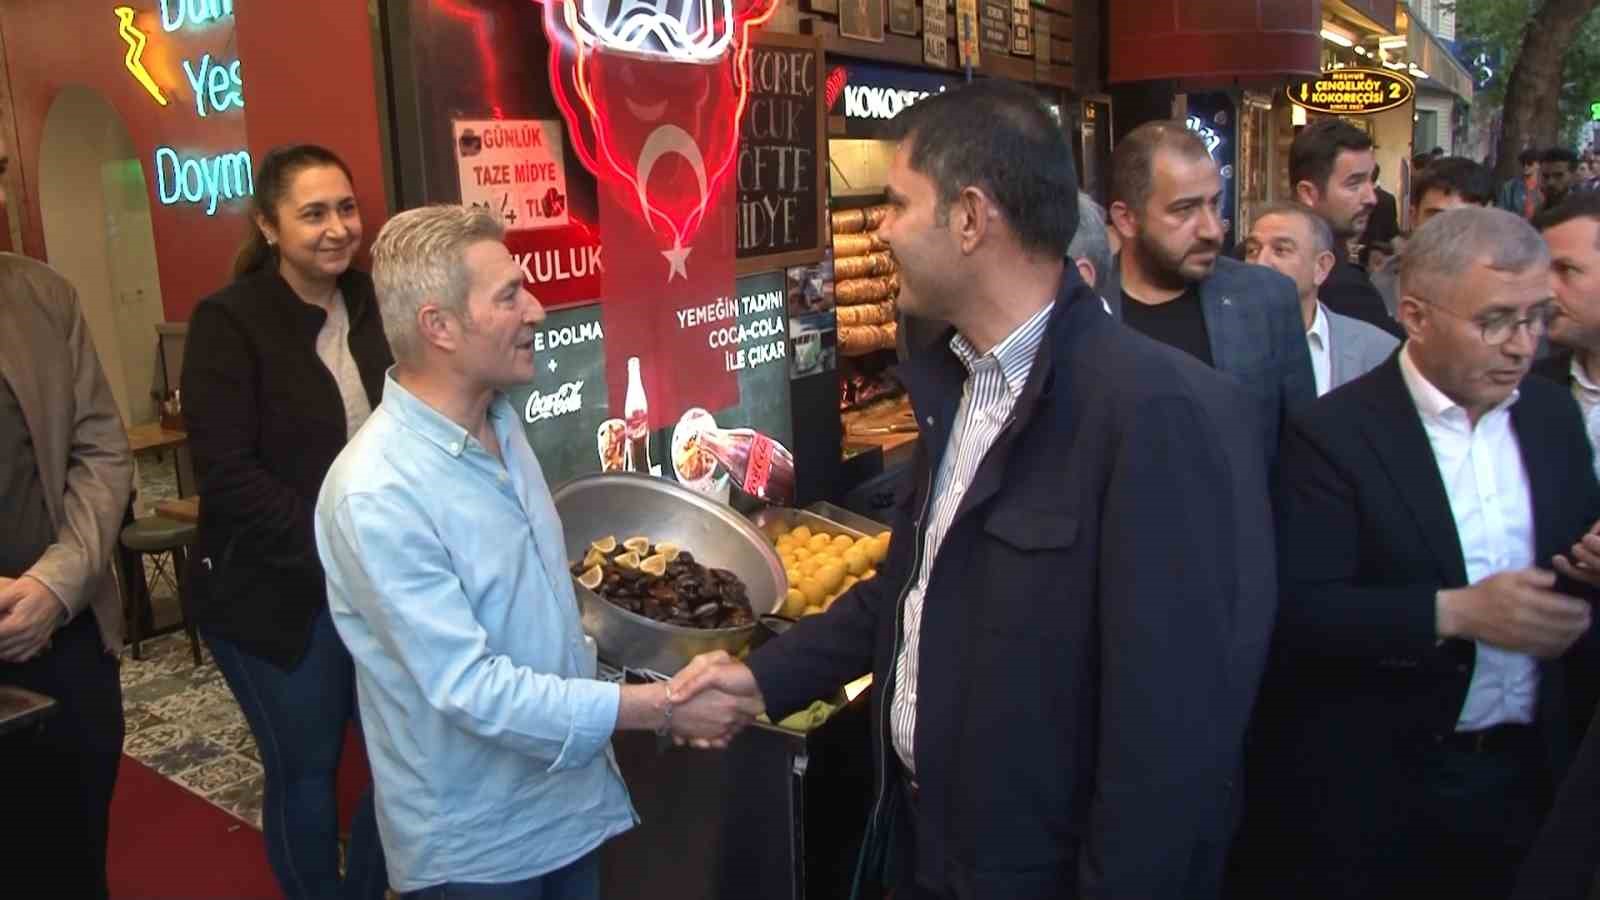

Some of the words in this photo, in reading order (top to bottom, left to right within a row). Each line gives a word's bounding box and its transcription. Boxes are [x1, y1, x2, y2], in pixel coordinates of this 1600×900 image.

[1311, 91, 1384, 105] KOKOREÇÇİSİ
[1315, 80, 1381, 92] ÇENGELKÖY
[1388, 82, 1401, 99] 2
[483, 125, 543, 149] GÜNLÜK
[473, 165, 511, 186] TAZE
[514, 160, 556, 183] MİDYE
[737, 143, 811, 192] ÖFTE
[514, 244, 605, 284] KULUK
[676, 297, 740, 329] YEMEĞİN
[741, 290, 783, 316] TADINI
[547, 320, 604, 349] DOLMA
[708, 316, 785, 349] COCA-COLA
[725, 349, 746, 373] İLE
[747, 340, 786, 369] ÇIKAR
